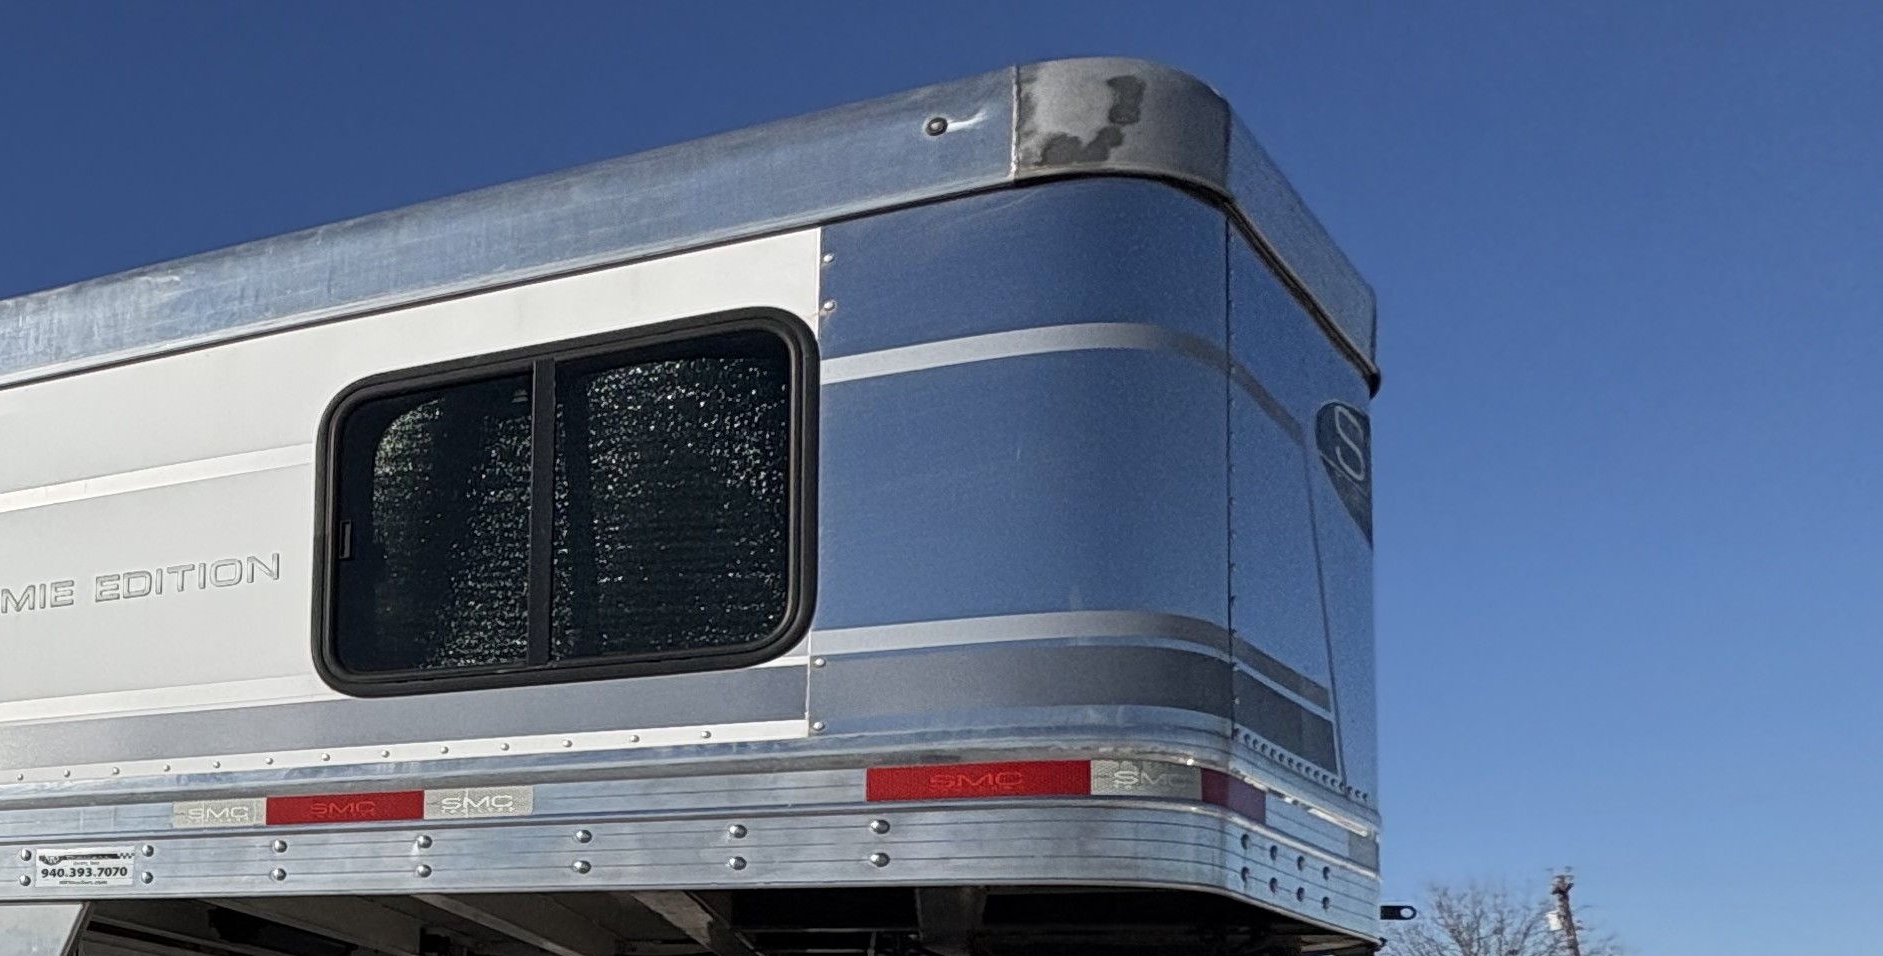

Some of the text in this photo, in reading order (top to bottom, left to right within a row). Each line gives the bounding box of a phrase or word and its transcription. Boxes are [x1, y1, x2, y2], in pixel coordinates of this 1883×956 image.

[94, 553, 281, 603] EDITION
[929, 771, 1023, 788] SMC
[1113, 770, 1188, 789] SMC
[310, 801, 376, 816] SMC
[441, 795, 514, 811] SMC
[188, 805, 249, 820] SMC
[40, 866, 129, 879] 940.393.7070
